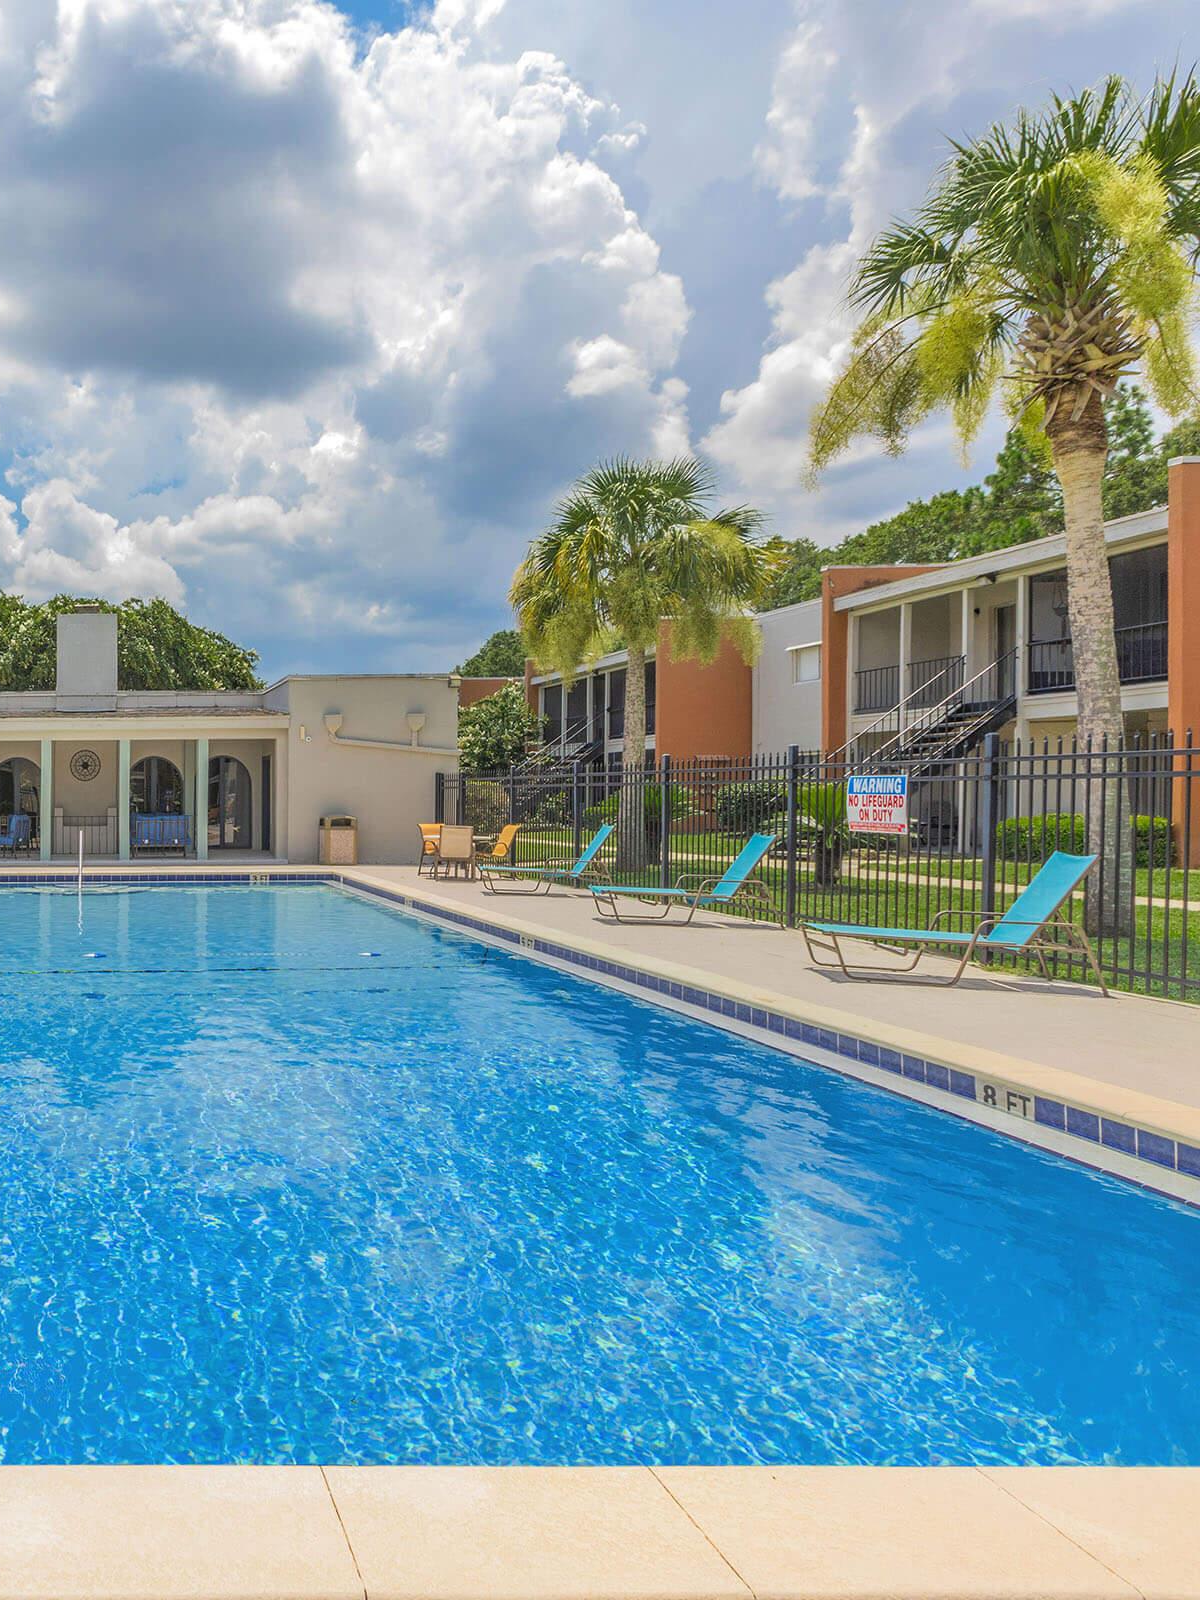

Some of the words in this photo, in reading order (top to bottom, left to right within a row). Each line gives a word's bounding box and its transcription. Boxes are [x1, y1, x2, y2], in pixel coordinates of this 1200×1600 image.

[853, 777, 902, 793] WARNING
[848, 795, 858, 807] NO
[862, 795, 904, 807] LIFEGUARD
[859, 809, 869, 821] ON
[873, 809, 893, 822] DUTY
[983, 1085, 997, 1105] 8
[1007, 1091, 1031, 1117] FT
